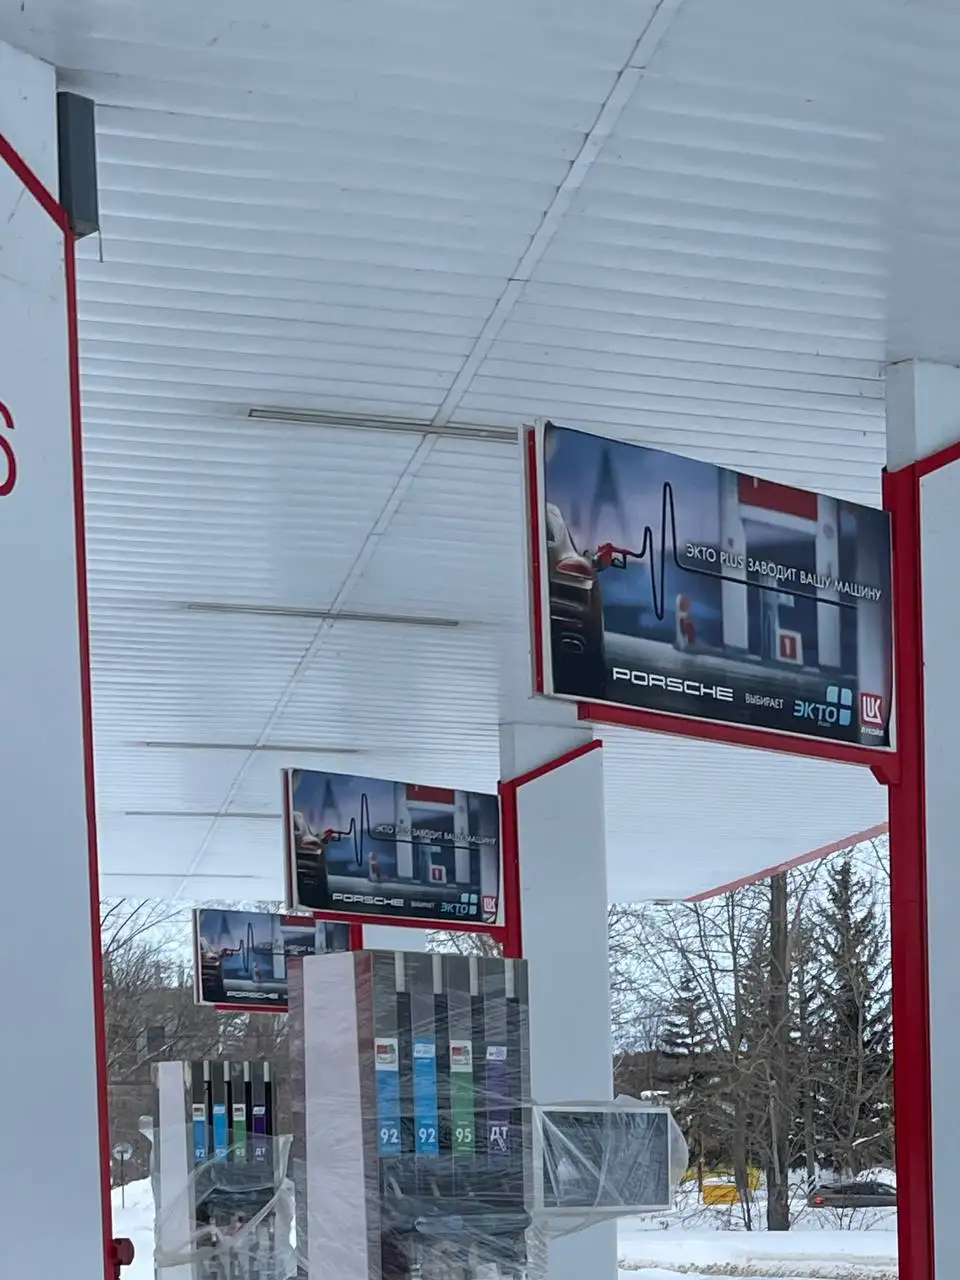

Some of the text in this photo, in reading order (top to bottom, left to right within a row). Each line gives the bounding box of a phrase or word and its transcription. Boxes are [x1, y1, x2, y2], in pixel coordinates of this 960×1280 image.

[686, 544, 882, 600] ЭКТО PLUS ЗАВОДИТ ВАШУ МАШИНУ
[612, 667, 734, 701] PORSCHE
[745, 693, 784, 709] ВЫБИРАЕТ
[793, 700, 838, 722] ЭКТО
[332, 893, 405, 907] PORSCHE
[440, 902, 468, 914] ЭКТО
[380, 1127, 400, 1144] 92
[418, 1127, 436, 1143] 92
[455, 1128, 472, 1143] 95
[490, 1126, 509, 1142] ДТ
